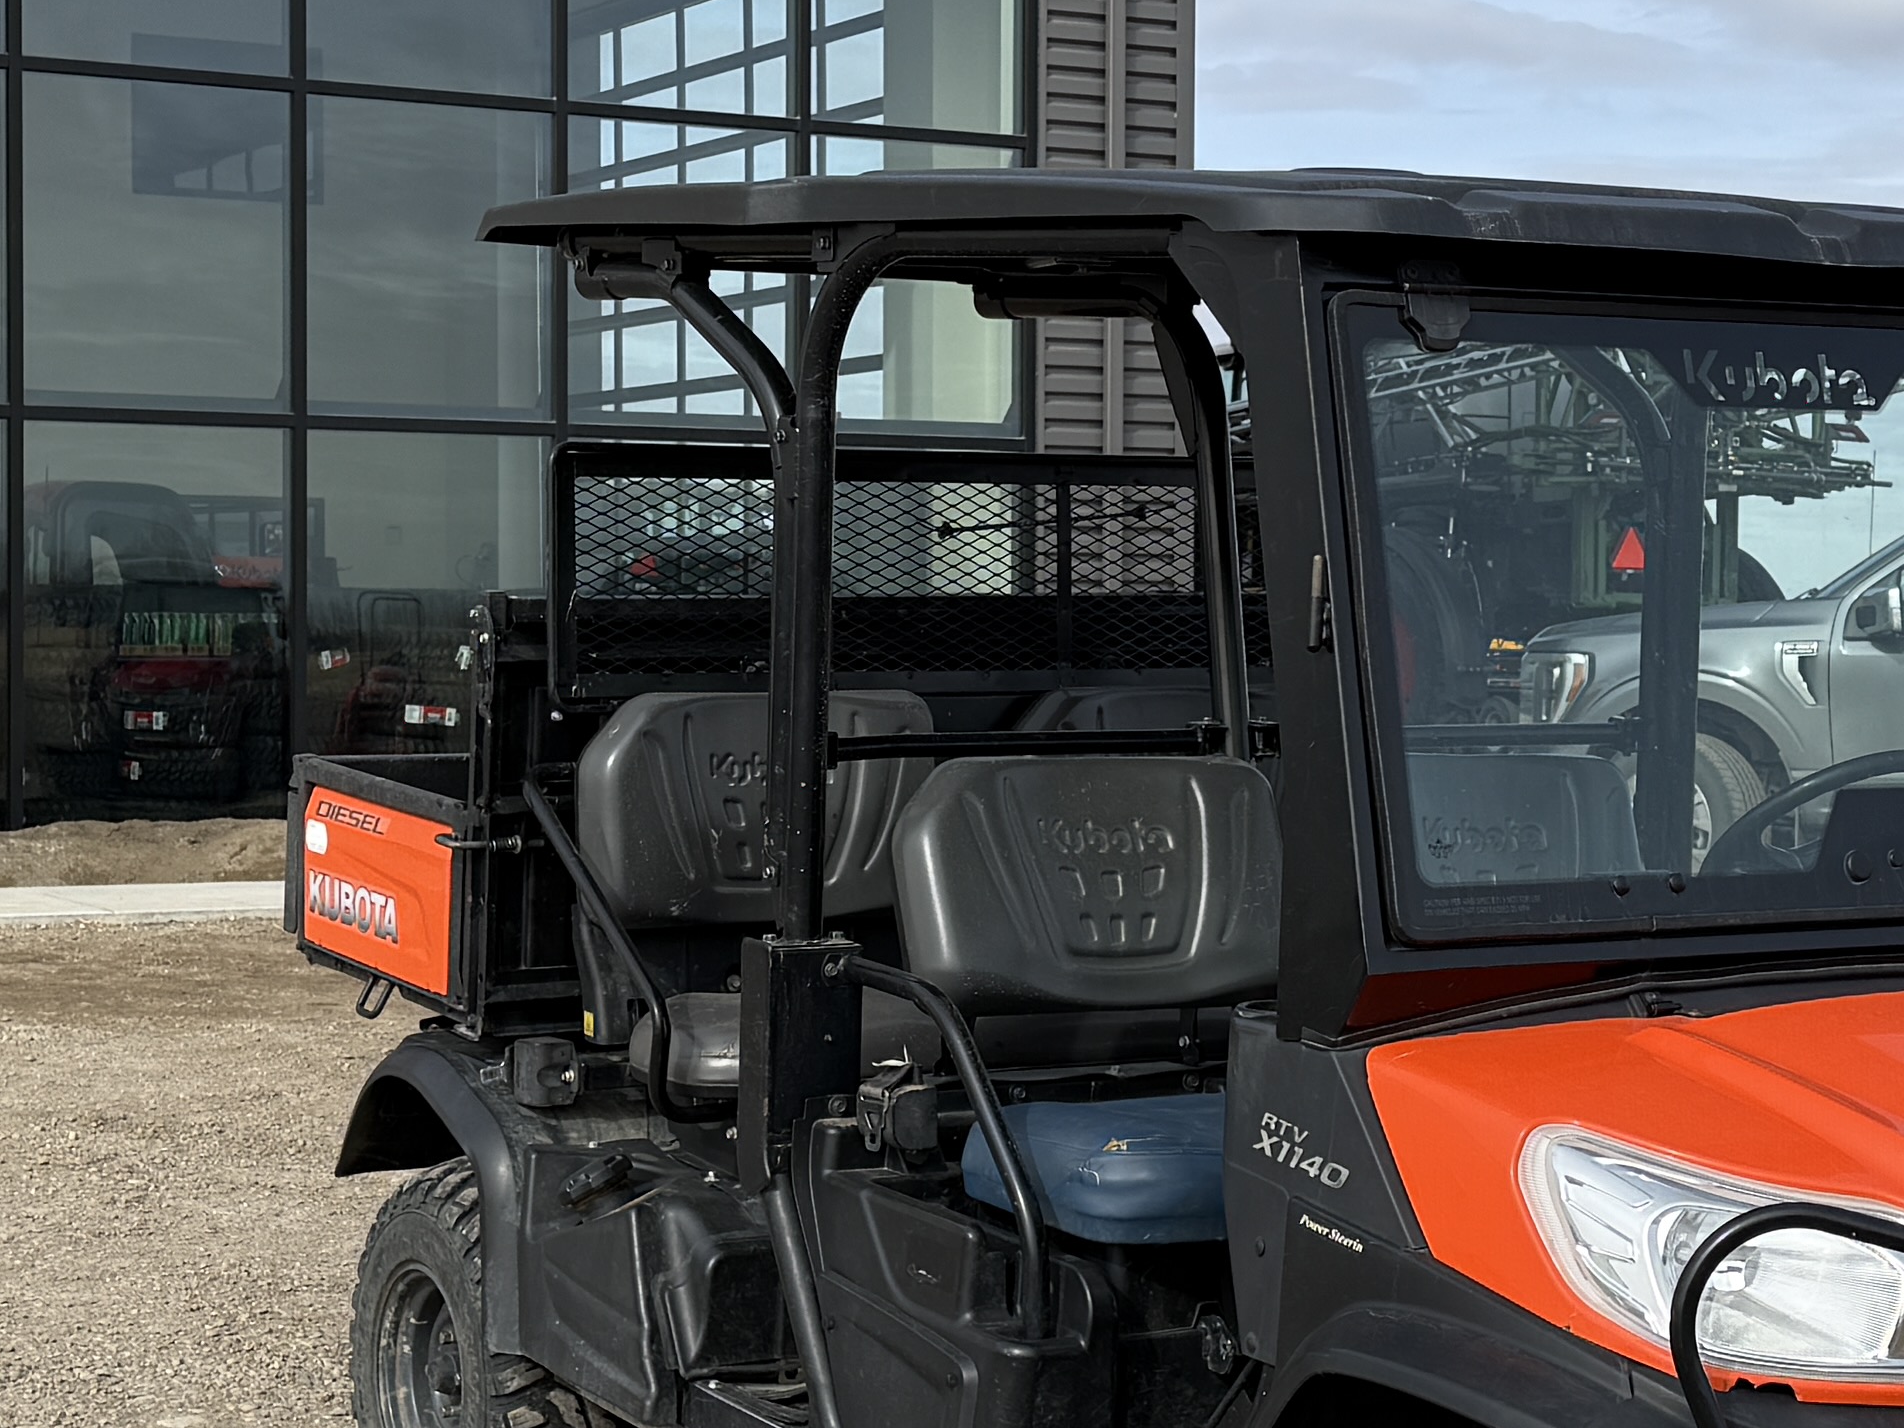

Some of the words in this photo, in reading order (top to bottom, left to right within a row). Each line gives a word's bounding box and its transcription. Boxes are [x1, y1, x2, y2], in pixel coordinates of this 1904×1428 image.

[1683, 348, 1876, 405] Kubota
[316, 800, 385, 835] DIESEL
[1037, 818, 1175, 855] Kubota
[309, 869, 399, 945] KUBOTA
[1261, 1112, 1309, 1144] RTV
[1252, 1128, 1351, 1189] X1140
